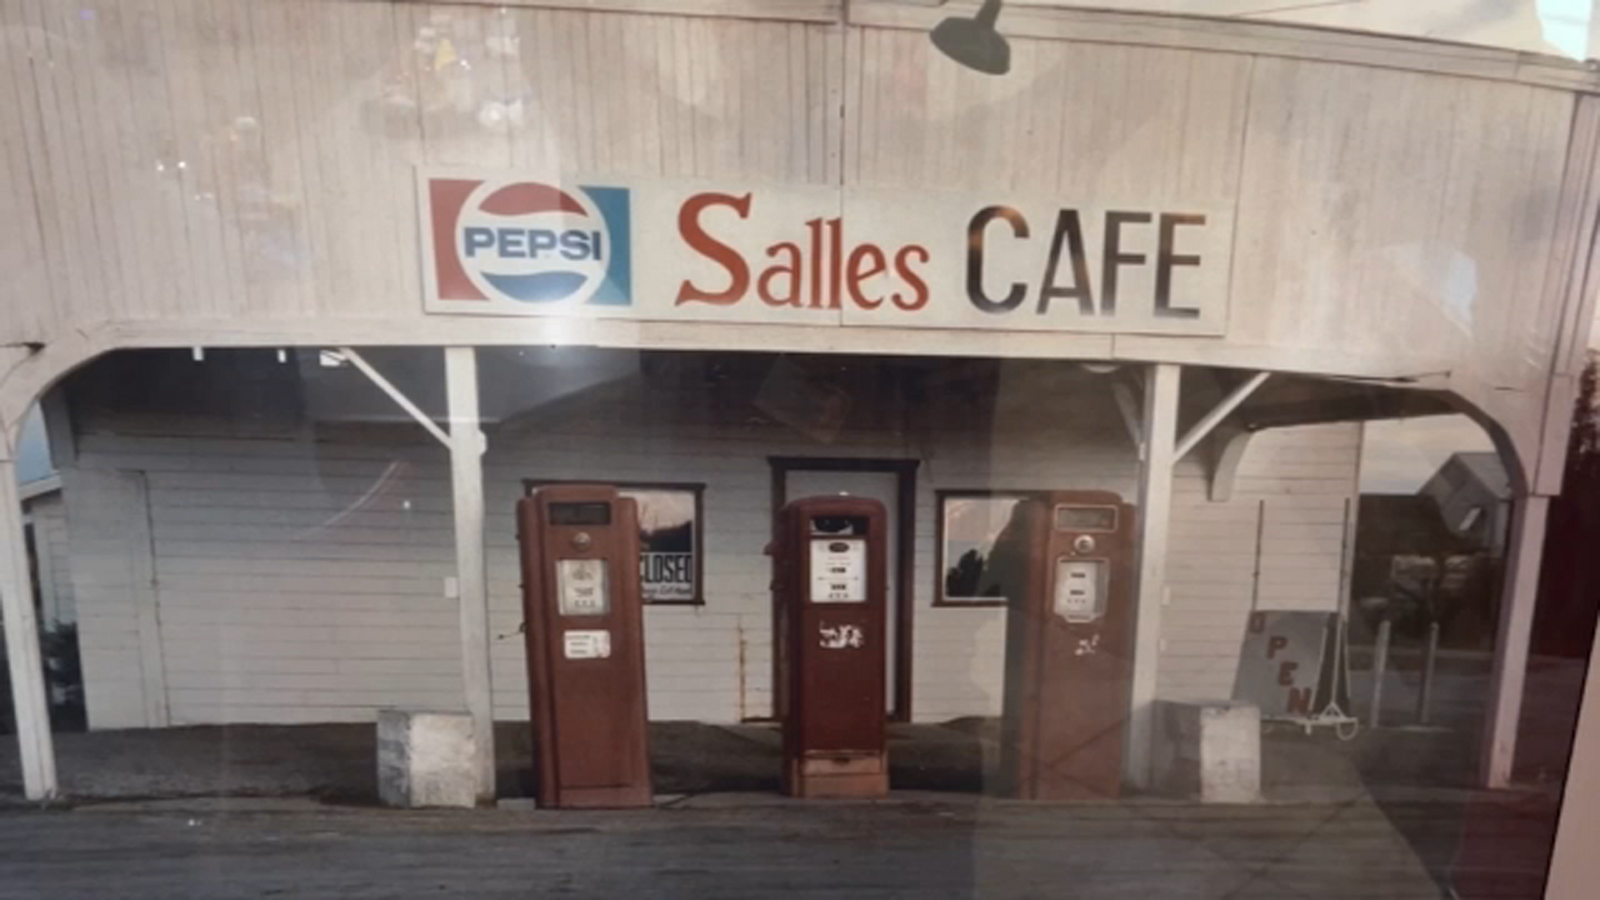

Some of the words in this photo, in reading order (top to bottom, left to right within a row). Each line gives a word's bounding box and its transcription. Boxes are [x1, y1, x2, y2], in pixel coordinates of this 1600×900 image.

[464, 227, 602, 261] PEPSI
[676, 192, 930, 312] Salles
[966, 205, 1206, 318] CAFE
[1248, 612, 1312, 715] OPEN
